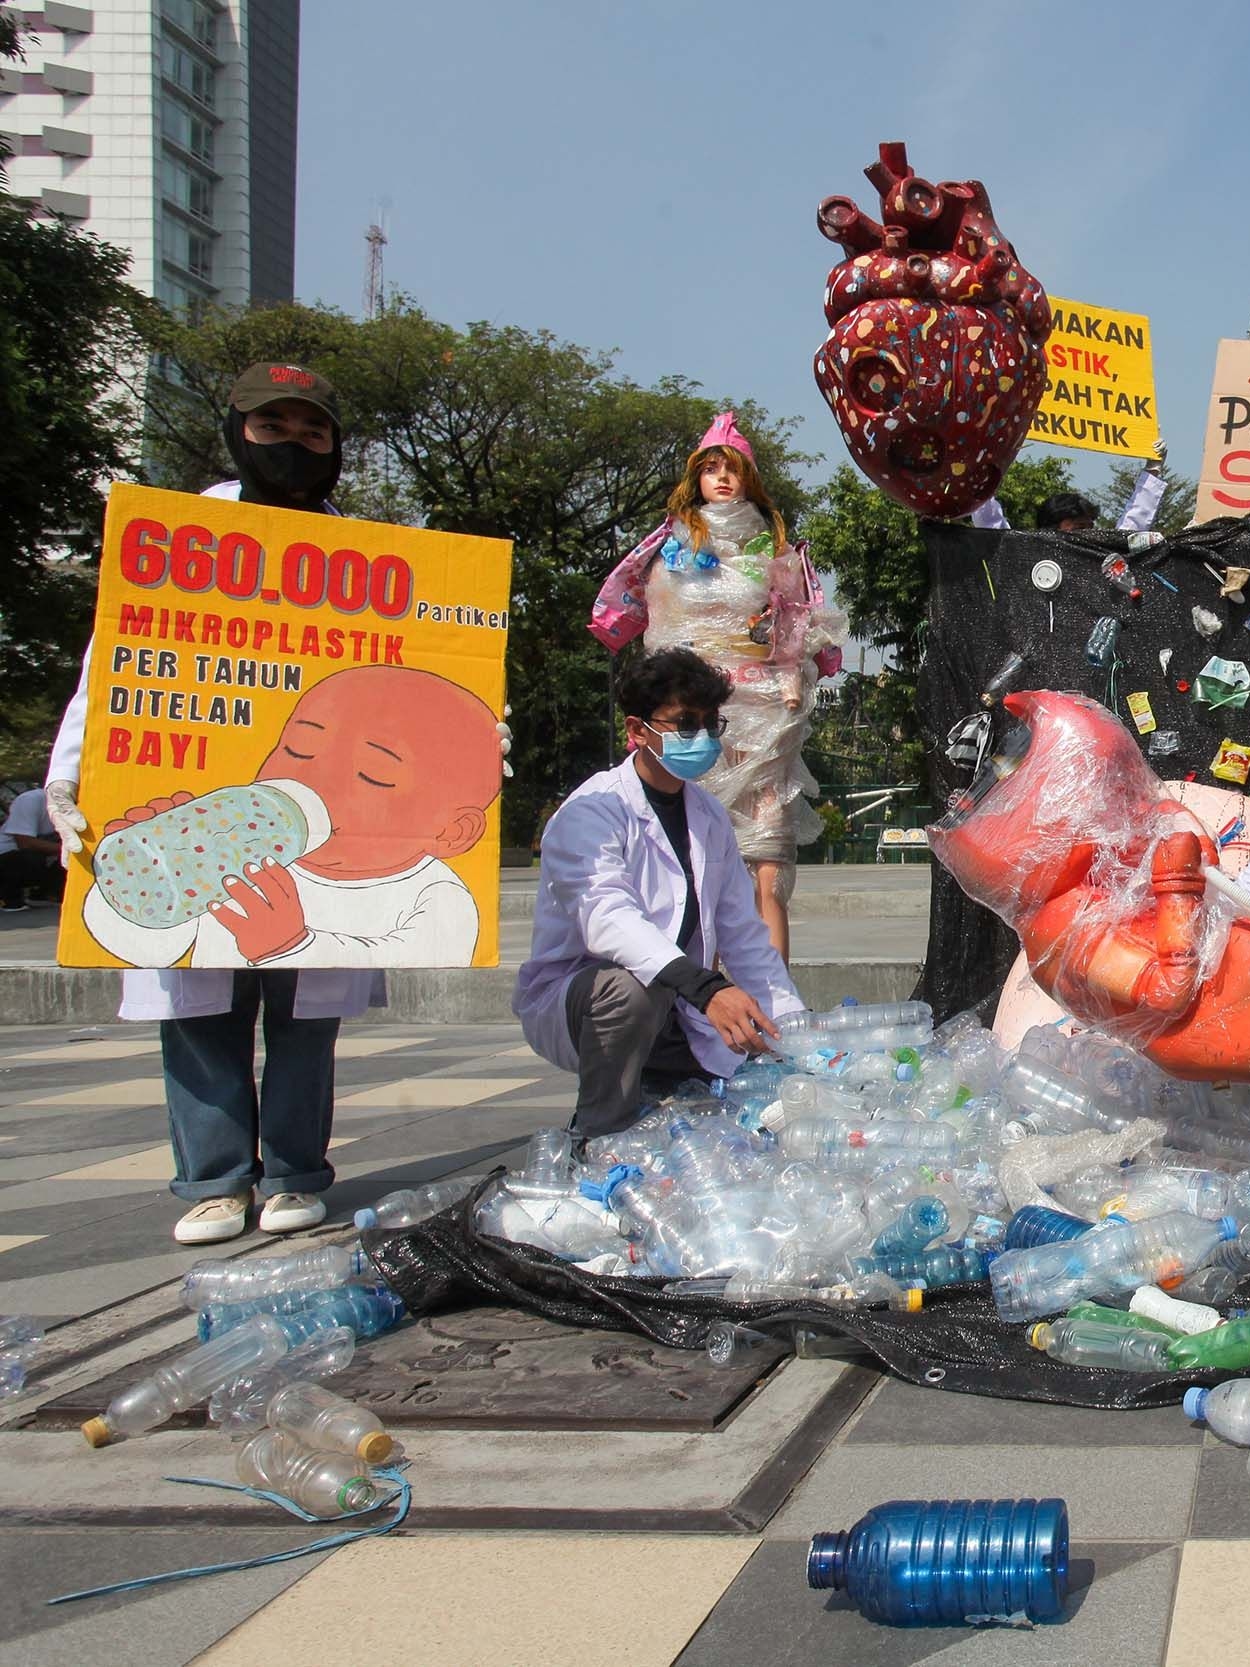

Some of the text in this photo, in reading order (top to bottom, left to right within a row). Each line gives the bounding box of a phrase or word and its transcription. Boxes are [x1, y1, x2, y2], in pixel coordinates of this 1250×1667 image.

[1051, 309, 1144, 349] MAKAN
[1097, 388, 1152, 419] TAK
[1028, 410, 1129, 448] RKUTIK
[120, 518, 414, 620] 660.000
[118, 604, 404, 665] MIKROPLASTIK
[416, 600, 508, 630] Partikel
[112, 646, 303, 692] PER TAHUN
[109, 686, 253, 727] DITELAN
[107, 727, 208, 770] BAYI
